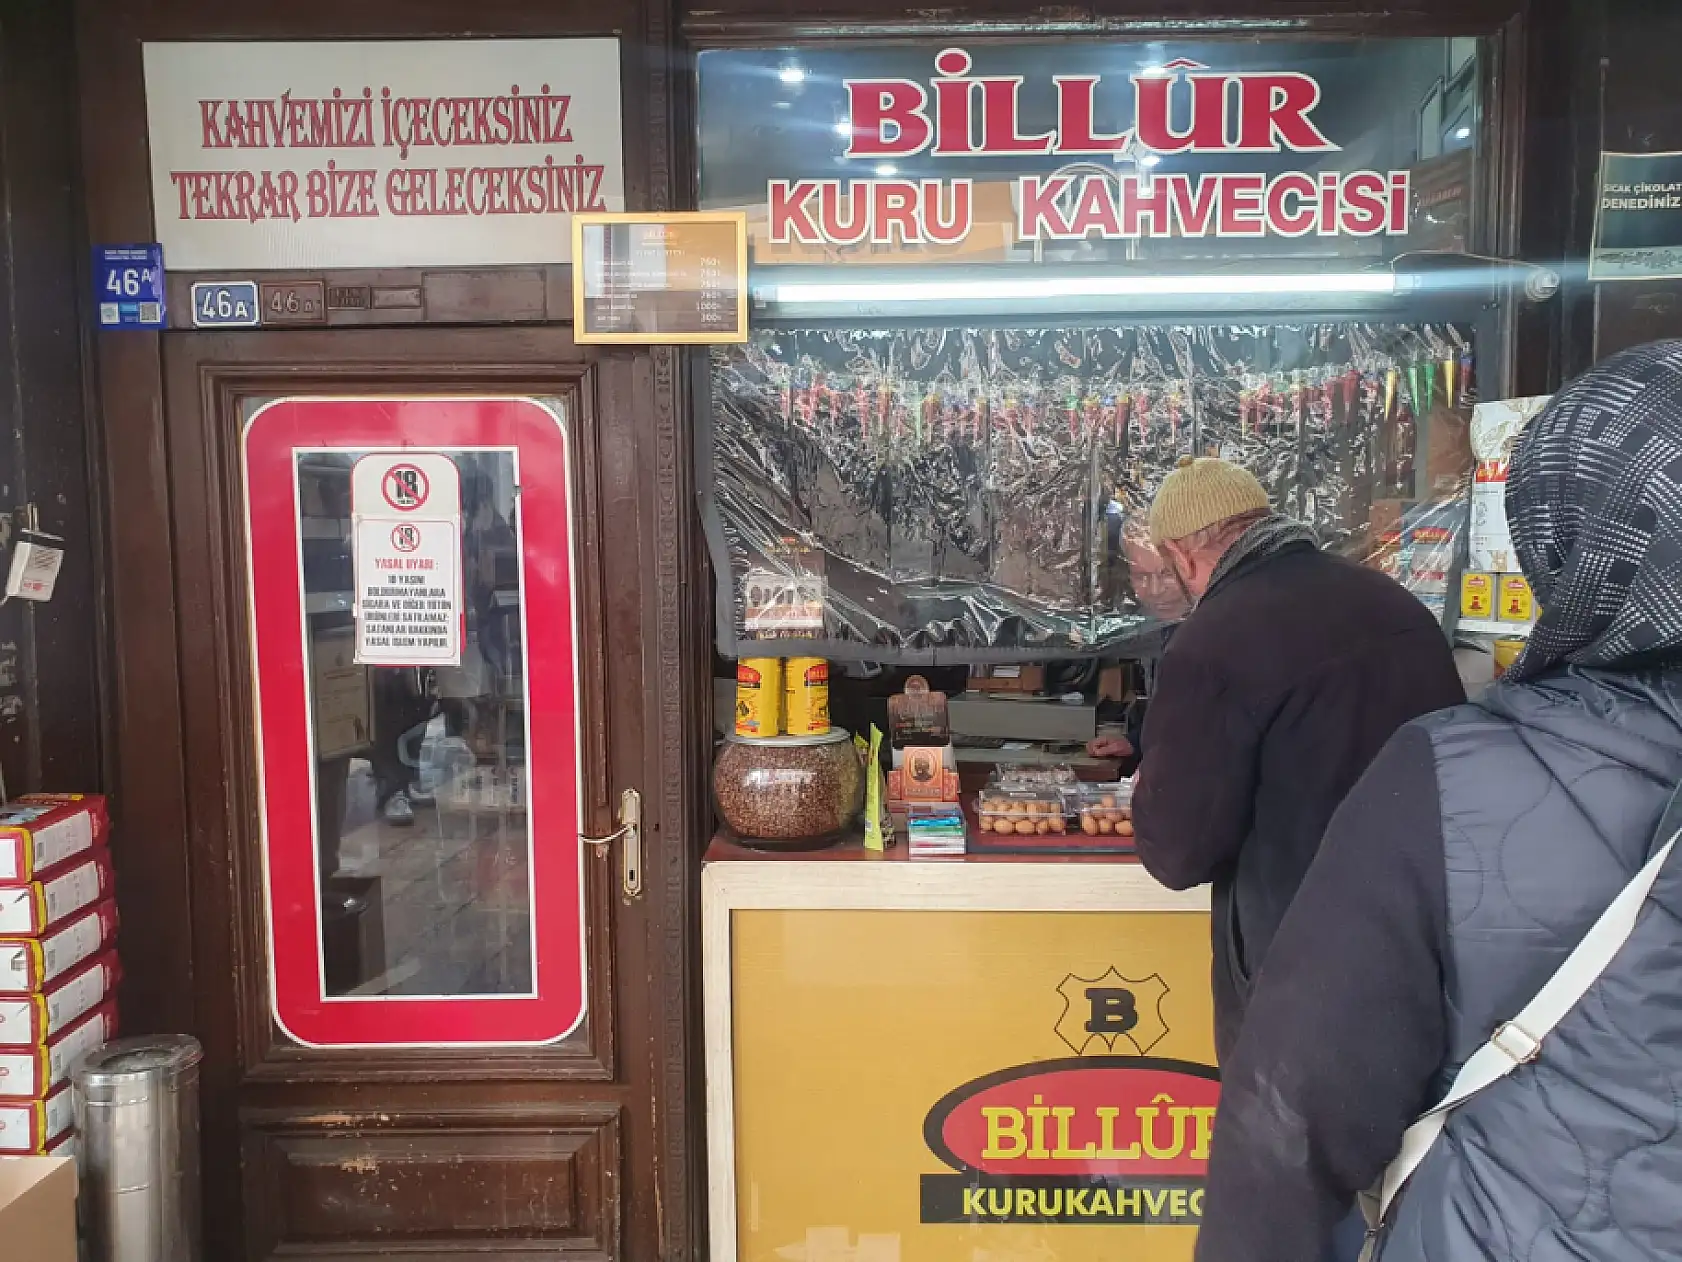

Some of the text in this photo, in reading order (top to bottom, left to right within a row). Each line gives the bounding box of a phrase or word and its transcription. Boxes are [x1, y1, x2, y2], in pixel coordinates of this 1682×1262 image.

[198, 84, 574, 160] KAHVEMİZİ İÇECEKSİNİZ
[170, 155, 607, 223] TEKRAR BİZE GELECEKSİNİZ
[767, 178, 974, 245] KURU
[1084, 987, 1138, 1033] B
